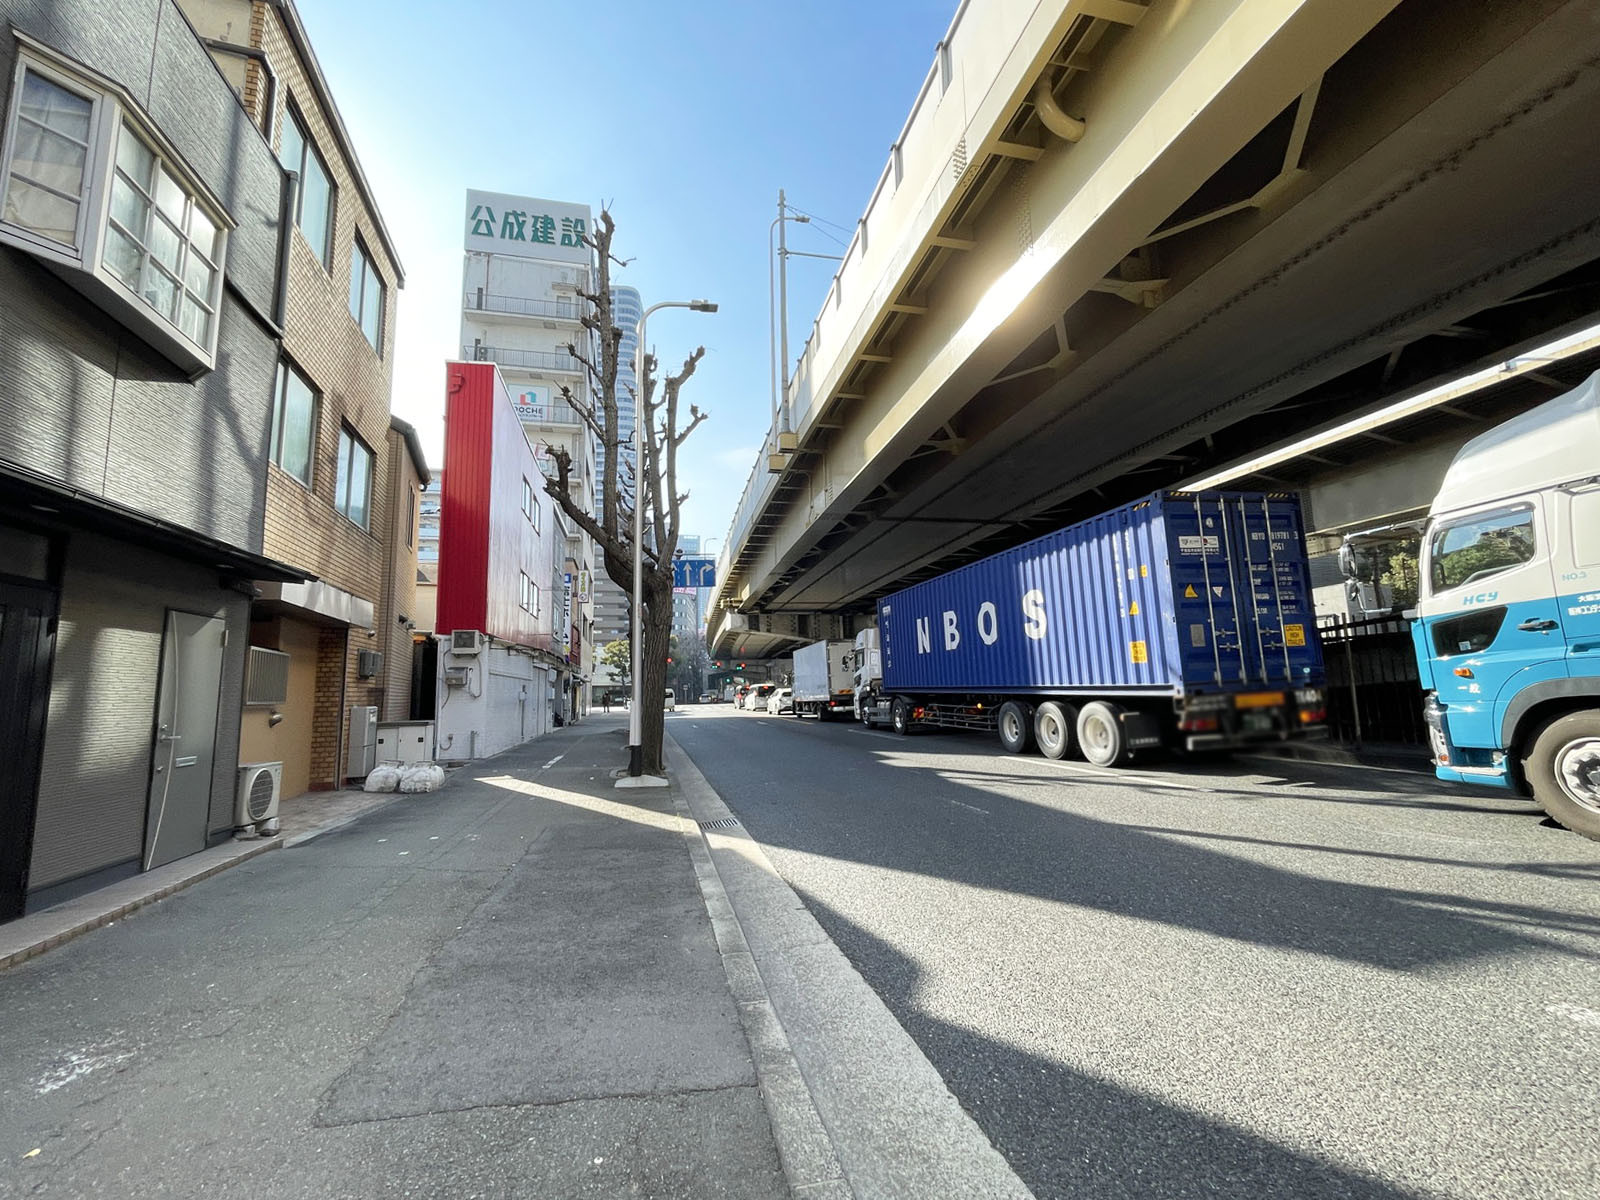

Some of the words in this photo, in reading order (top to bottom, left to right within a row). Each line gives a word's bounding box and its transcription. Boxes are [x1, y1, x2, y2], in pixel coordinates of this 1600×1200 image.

[471, 205, 585, 248] 公成建設
[1463, 591, 1499, 606] HCY
[916, 589, 1048, 655] NBOS
